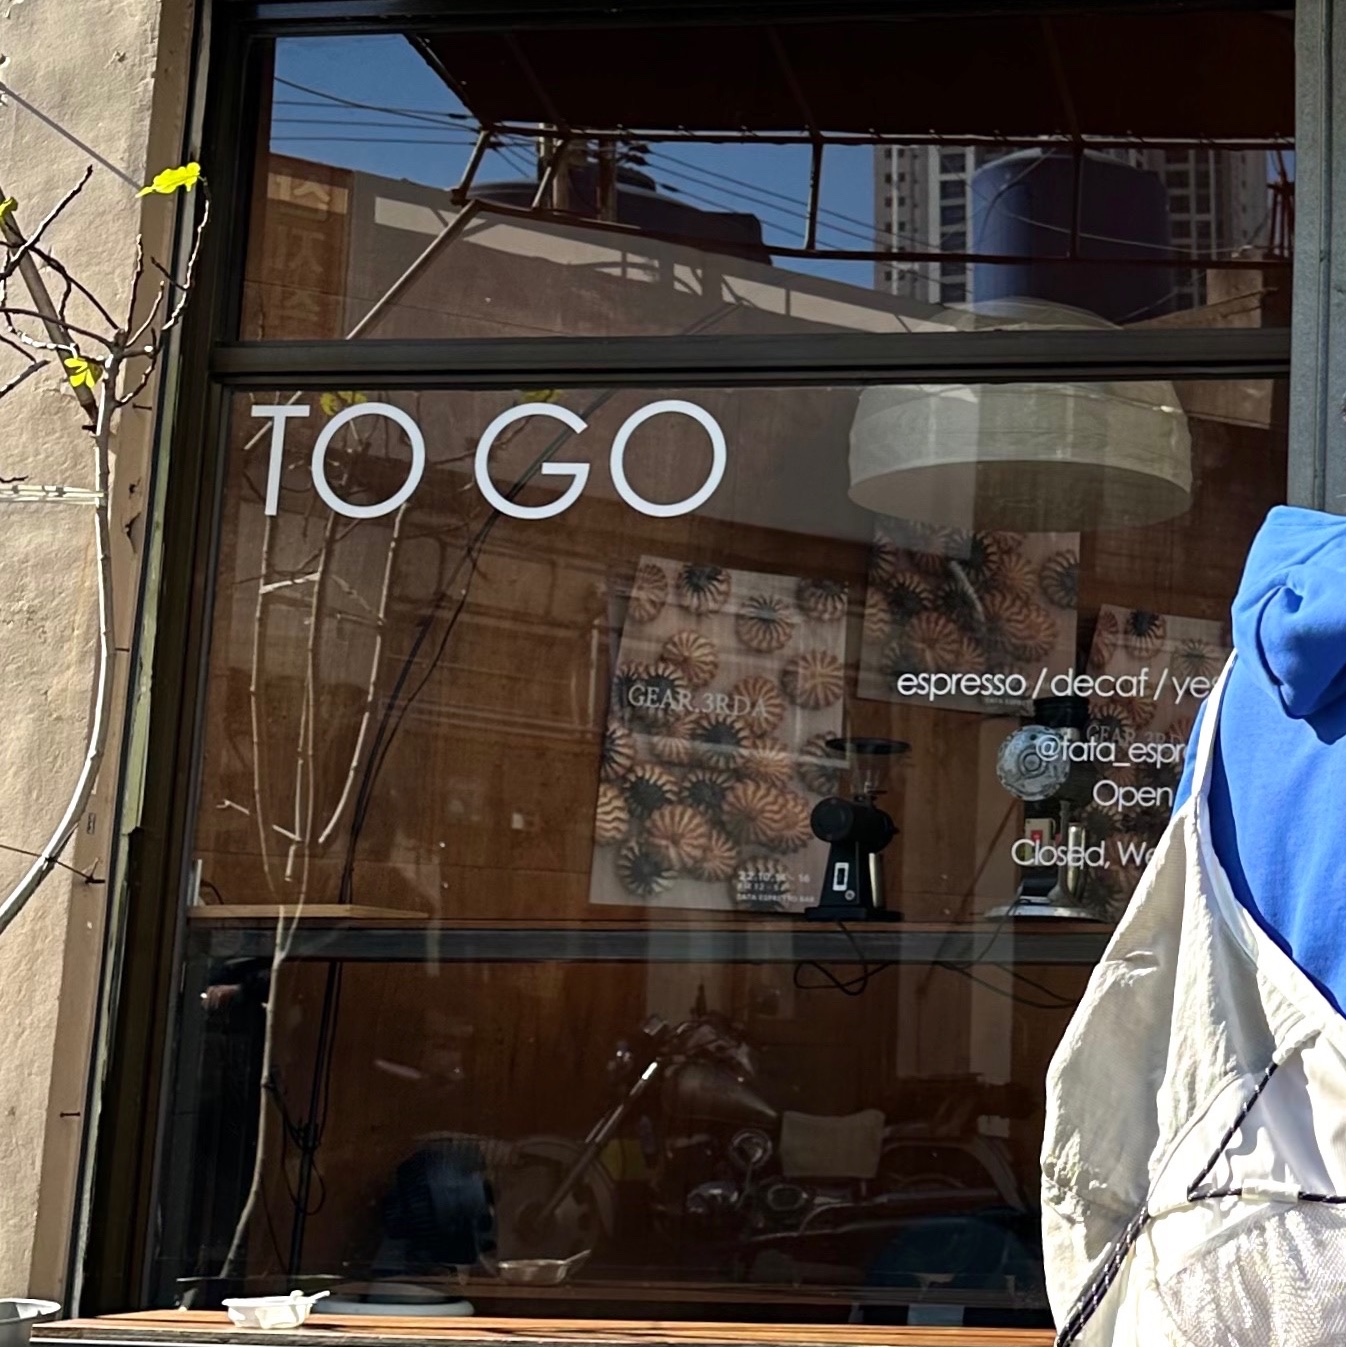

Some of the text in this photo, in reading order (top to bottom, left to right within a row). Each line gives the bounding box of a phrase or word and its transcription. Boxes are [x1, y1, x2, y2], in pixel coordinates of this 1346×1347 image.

[250, 399, 728, 520] TO GO
[896, 672, 1028, 702] espresso
[1050, 667, 1150, 698] decaf
[1035, 734, 1189, 769] @tata_espr
[1092, 779, 1174, 812] Open
[1011, 838, 1111, 869] Closed,
